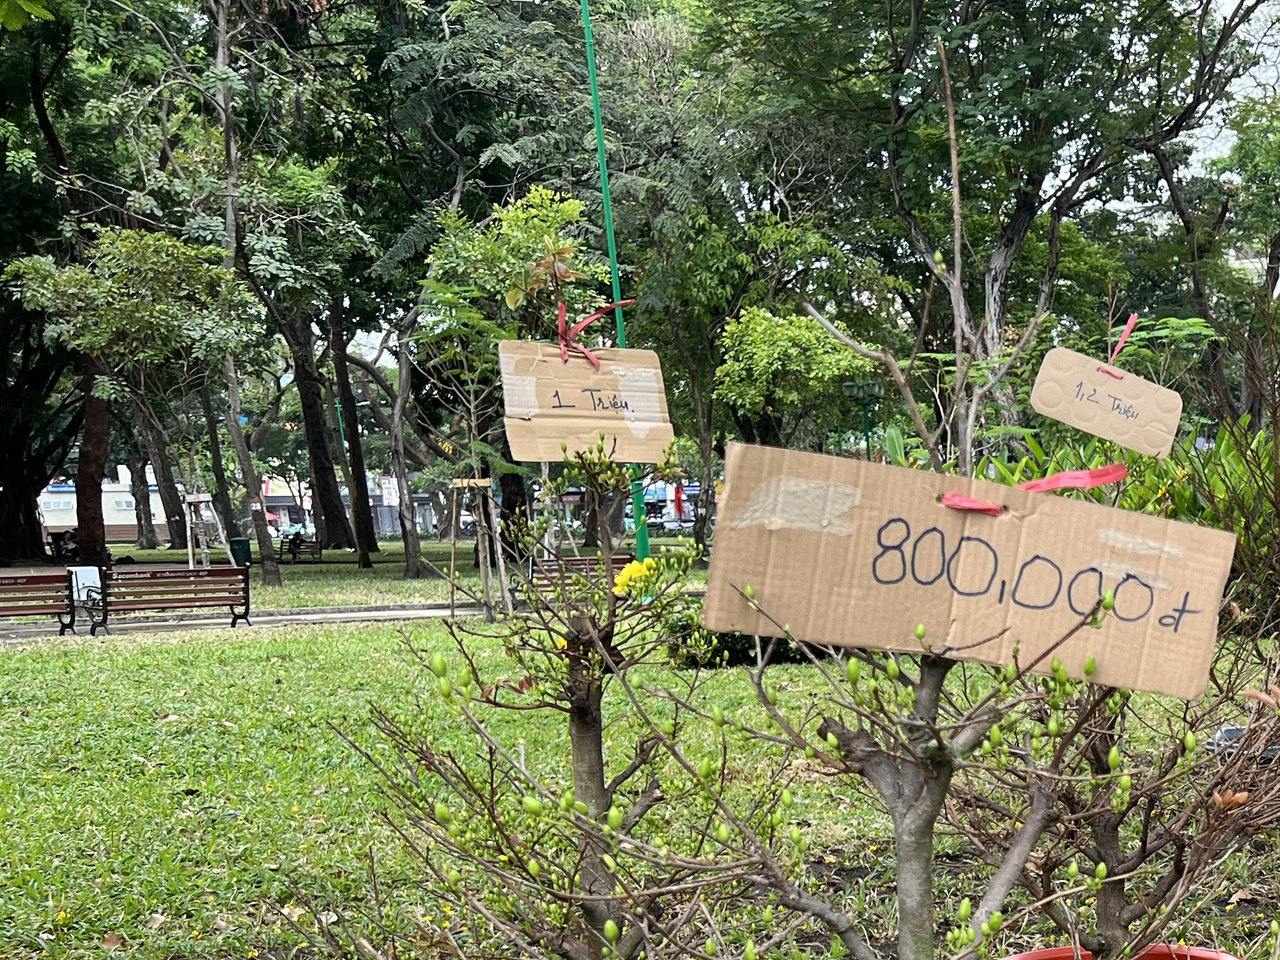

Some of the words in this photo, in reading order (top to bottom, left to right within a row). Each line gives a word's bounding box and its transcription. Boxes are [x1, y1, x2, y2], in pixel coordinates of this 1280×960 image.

[551, 389, 576, 409] 1
[1075, 380, 1099, 405] 1,2
[872, 516, 1202, 634] 800,000đ
